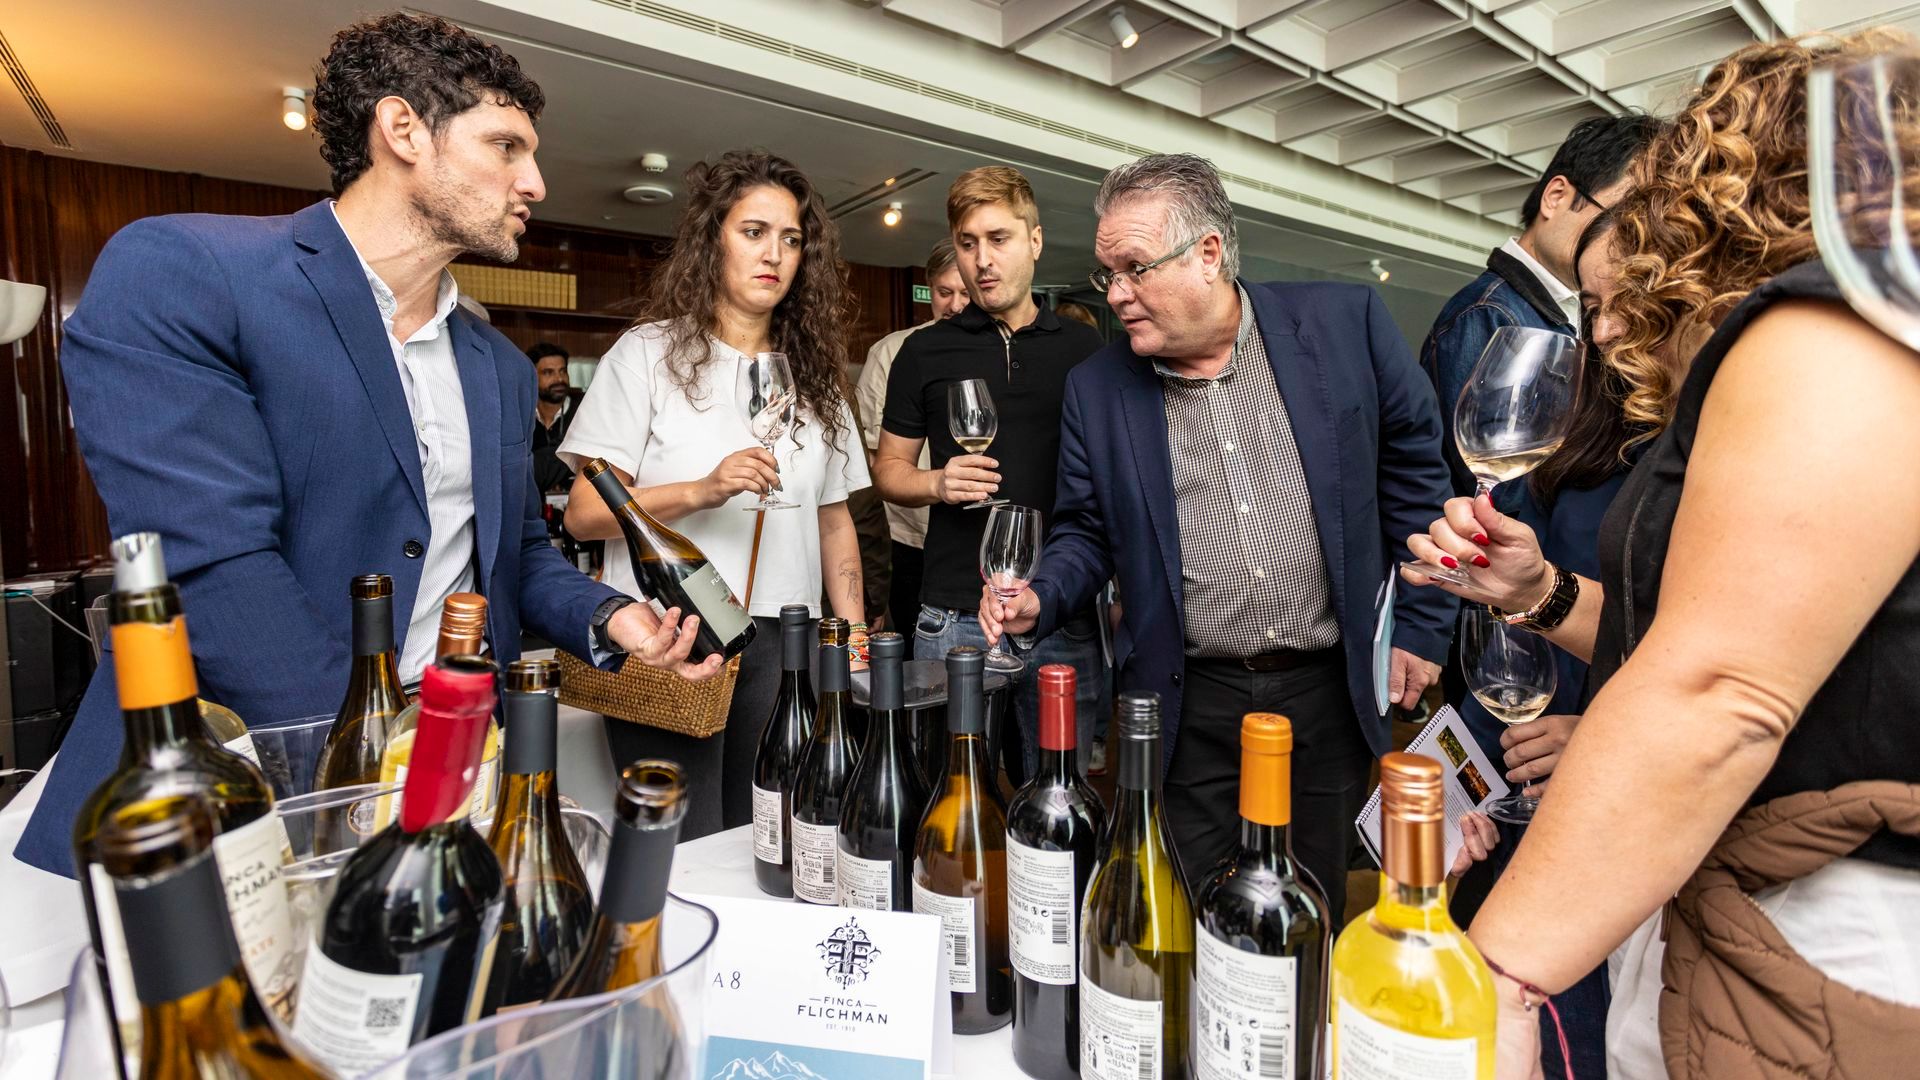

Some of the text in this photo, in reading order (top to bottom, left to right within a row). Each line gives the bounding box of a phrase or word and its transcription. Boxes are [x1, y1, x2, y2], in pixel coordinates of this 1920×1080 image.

[712, 971, 741, 990] A 8
[823, 996, 862, 1008] FINCA
[797, 1004, 888, 1025] FLICHMAN
